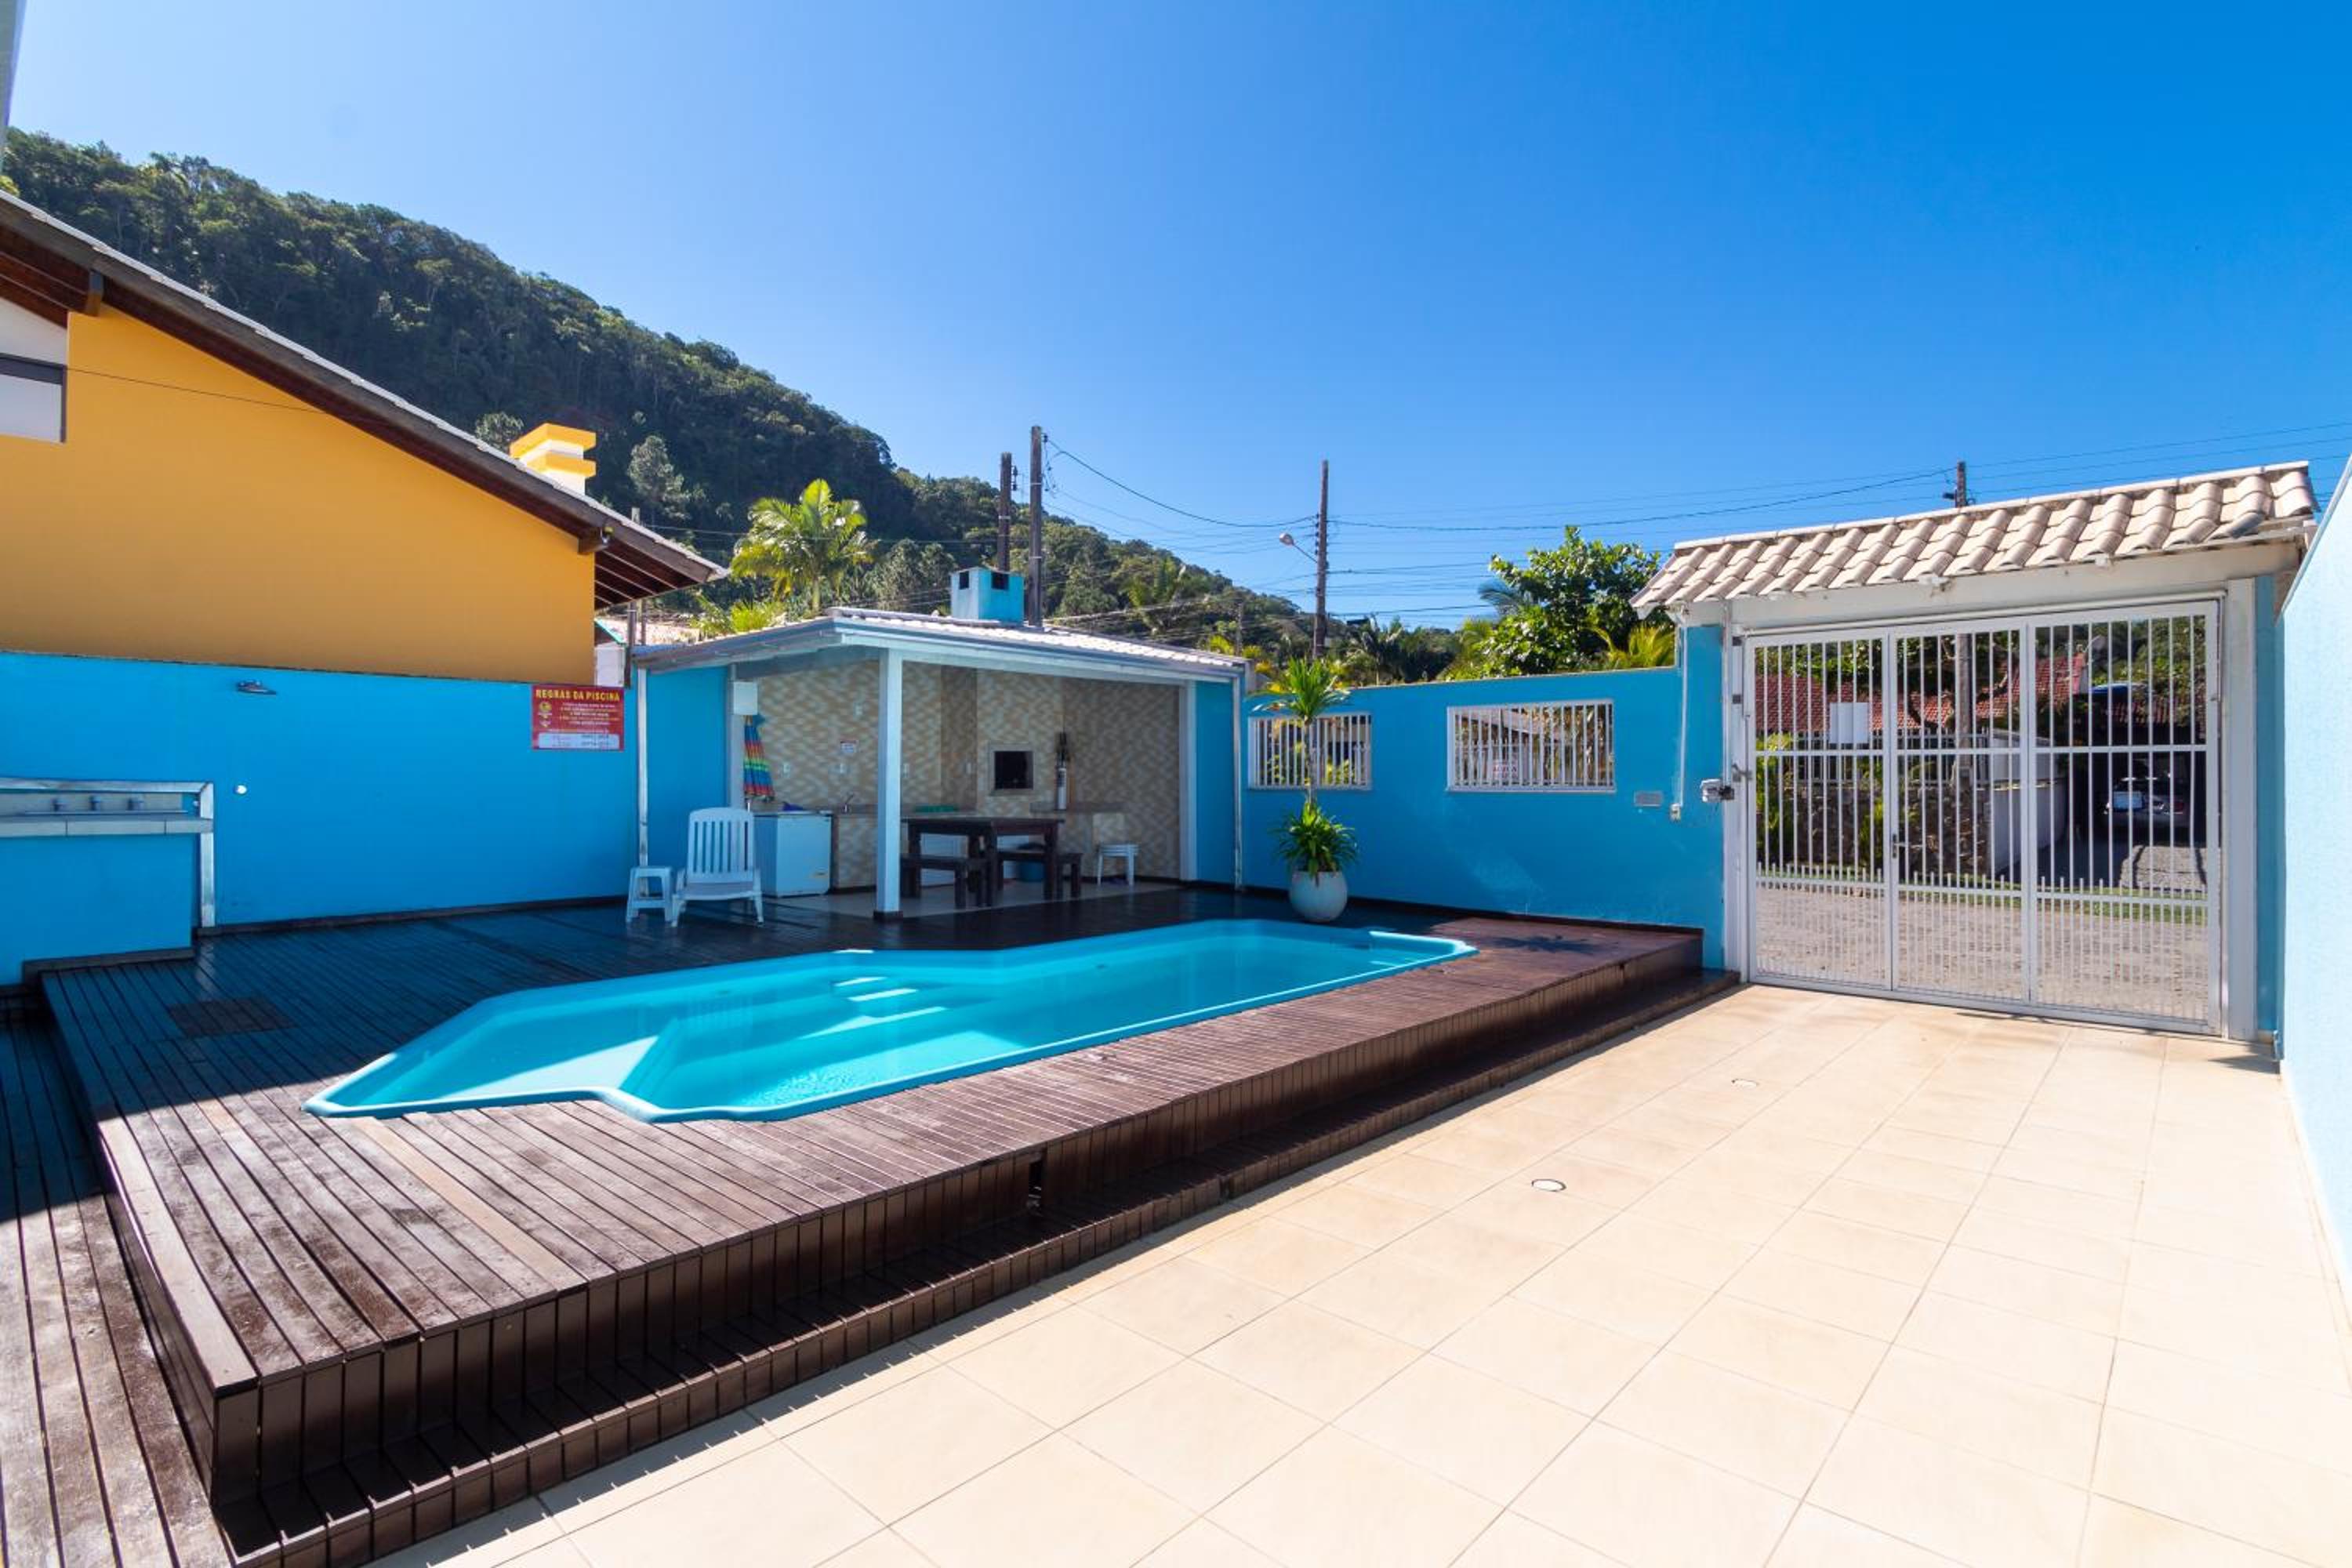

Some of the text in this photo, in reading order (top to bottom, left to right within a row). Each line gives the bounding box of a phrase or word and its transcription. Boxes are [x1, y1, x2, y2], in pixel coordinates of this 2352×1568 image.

[535, 689, 620, 702] REGRAS DA PISCINA
